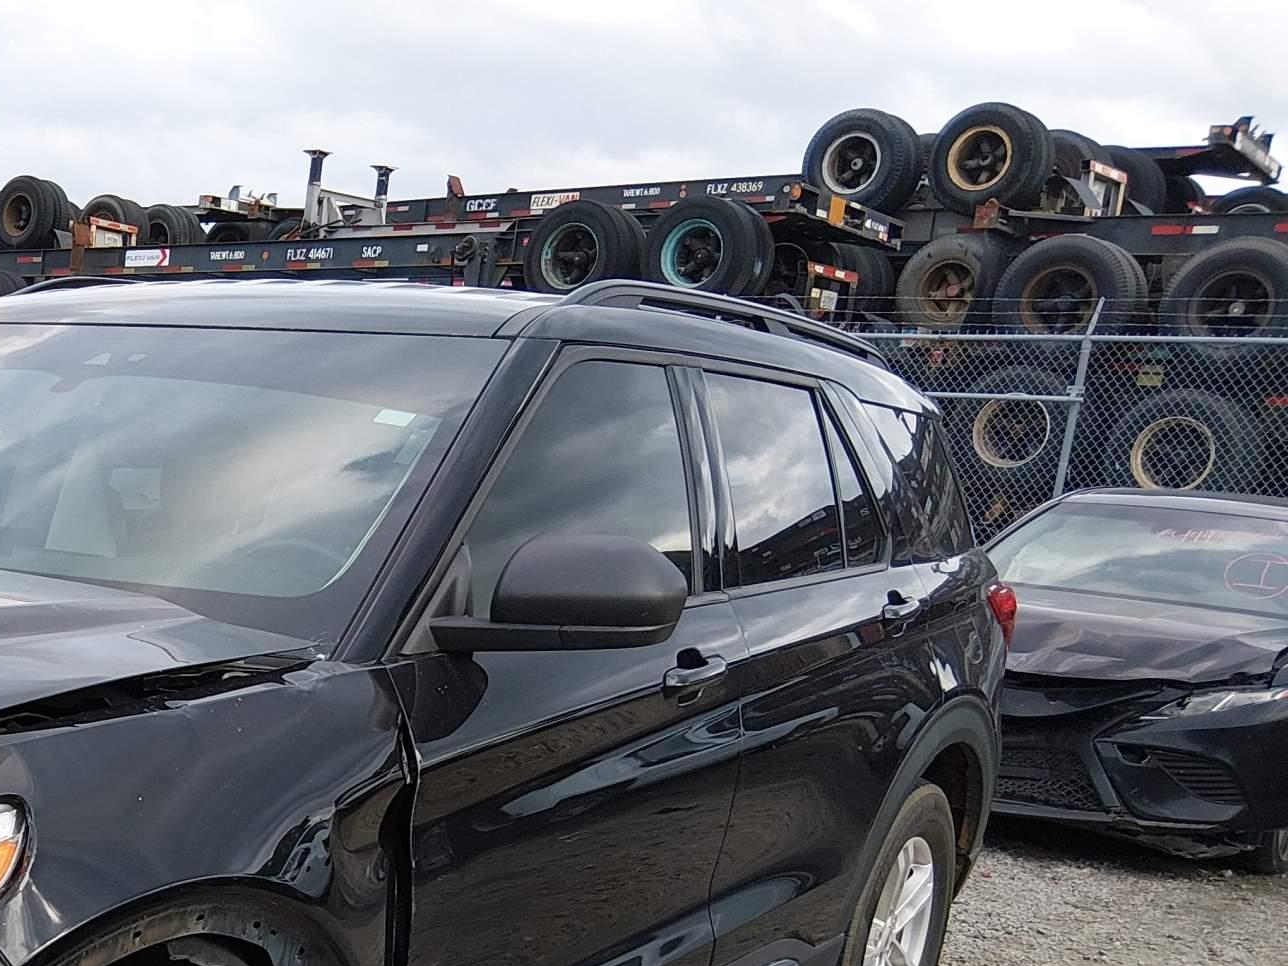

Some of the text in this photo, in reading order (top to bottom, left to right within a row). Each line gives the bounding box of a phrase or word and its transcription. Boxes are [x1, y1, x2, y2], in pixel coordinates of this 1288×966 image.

[706, 181, 763, 195] FLXZ 438369
[286, 247, 334, 260] FLXZ 414671
[362, 246, 382, 258] SACP
